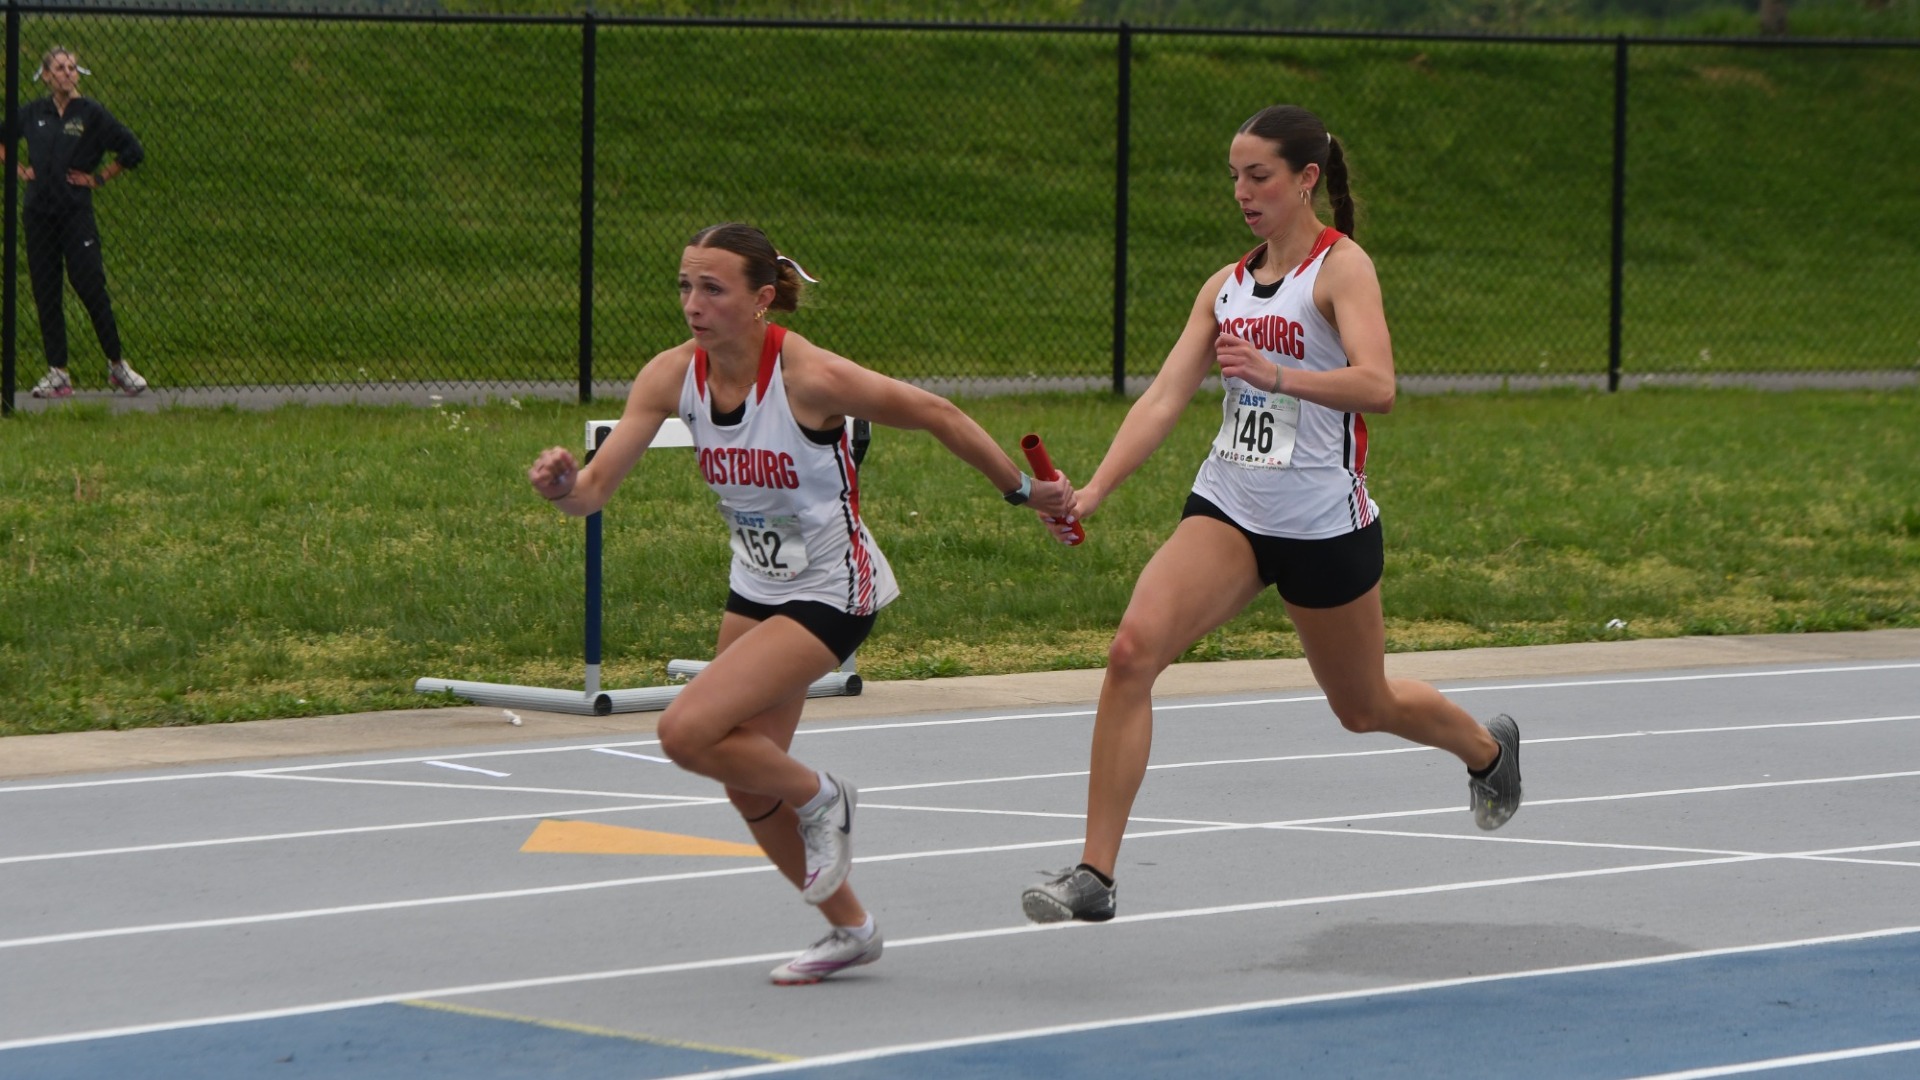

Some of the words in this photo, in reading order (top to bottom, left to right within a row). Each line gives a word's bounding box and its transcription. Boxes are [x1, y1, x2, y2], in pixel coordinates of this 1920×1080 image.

[1218, 315, 1304, 360] OSTBURG
[1239, 394, 1266, 408] EAST
[1233, 408, 1274, 454] 146
[695, 447, 799, 489] OSTBURG
[734, 514, 765, 529] EAST
[736, 527, 788, 569] 152
